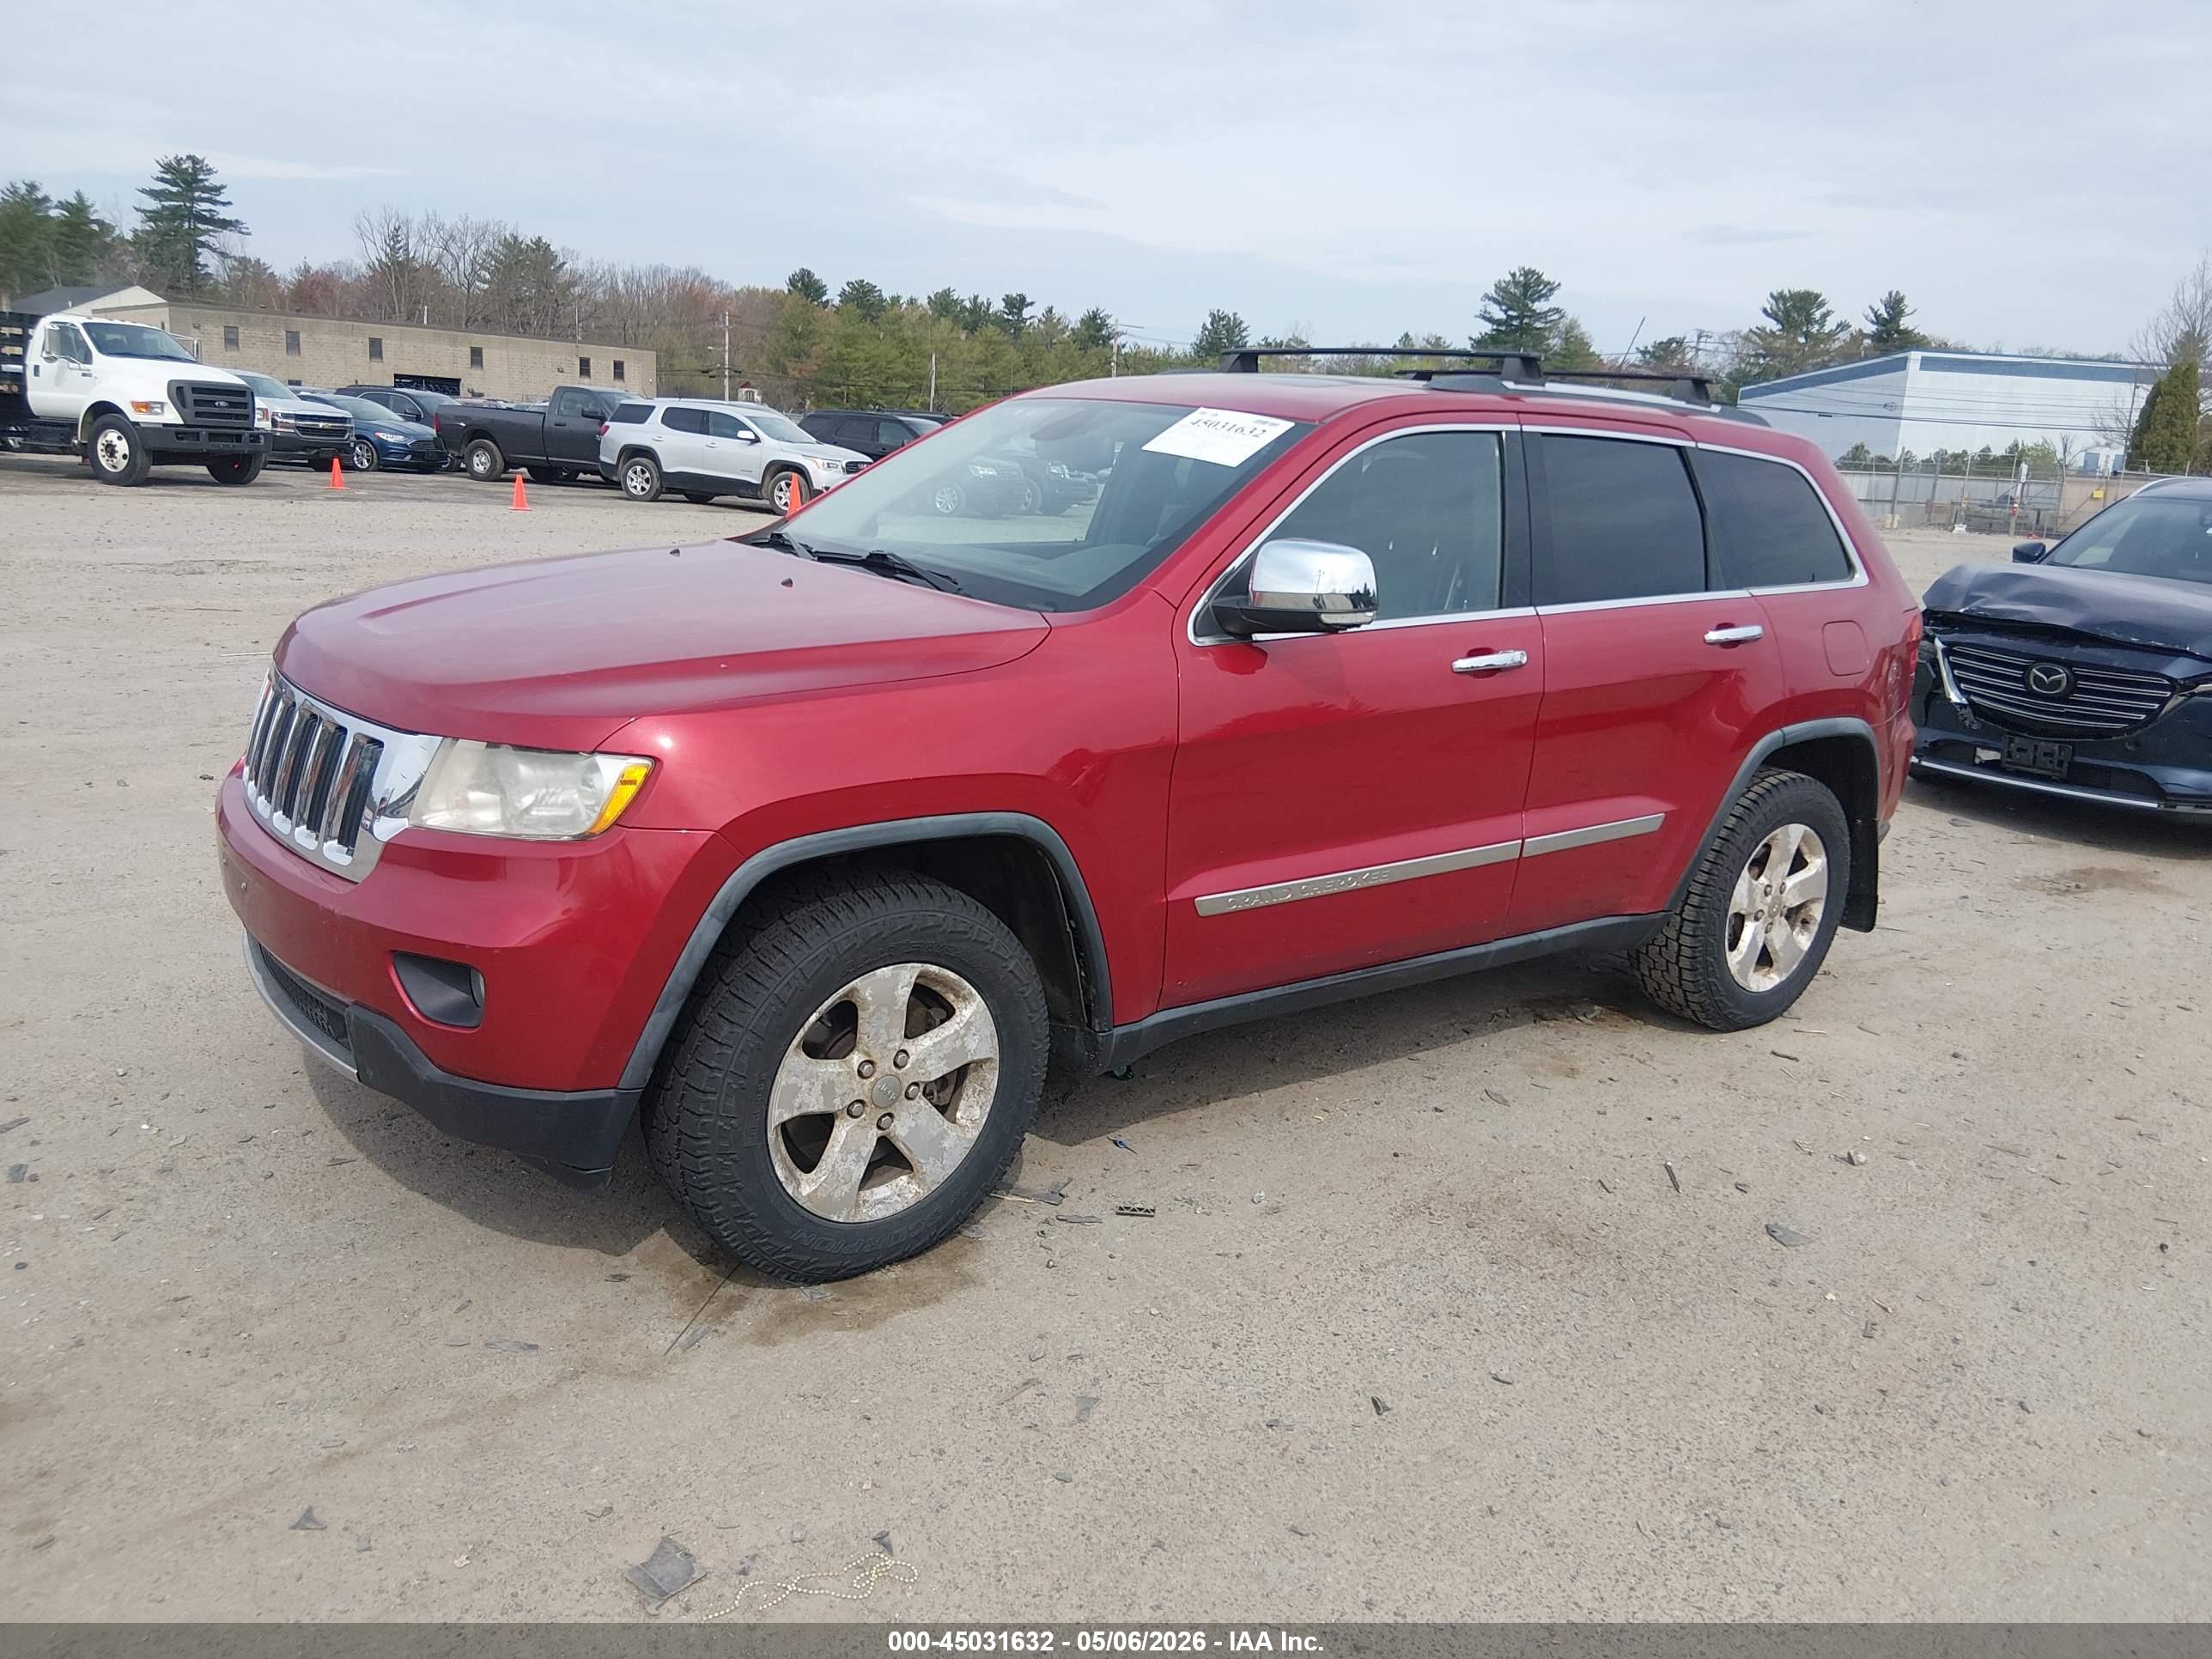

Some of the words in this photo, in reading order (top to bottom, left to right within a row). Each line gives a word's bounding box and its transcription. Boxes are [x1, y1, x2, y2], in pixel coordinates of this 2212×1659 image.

[1189, 418, 1267, 438] 45031632
[1227, 887, 1292, 910] GRAND
[1300, 870, 1391, 896] CHEROKEE
